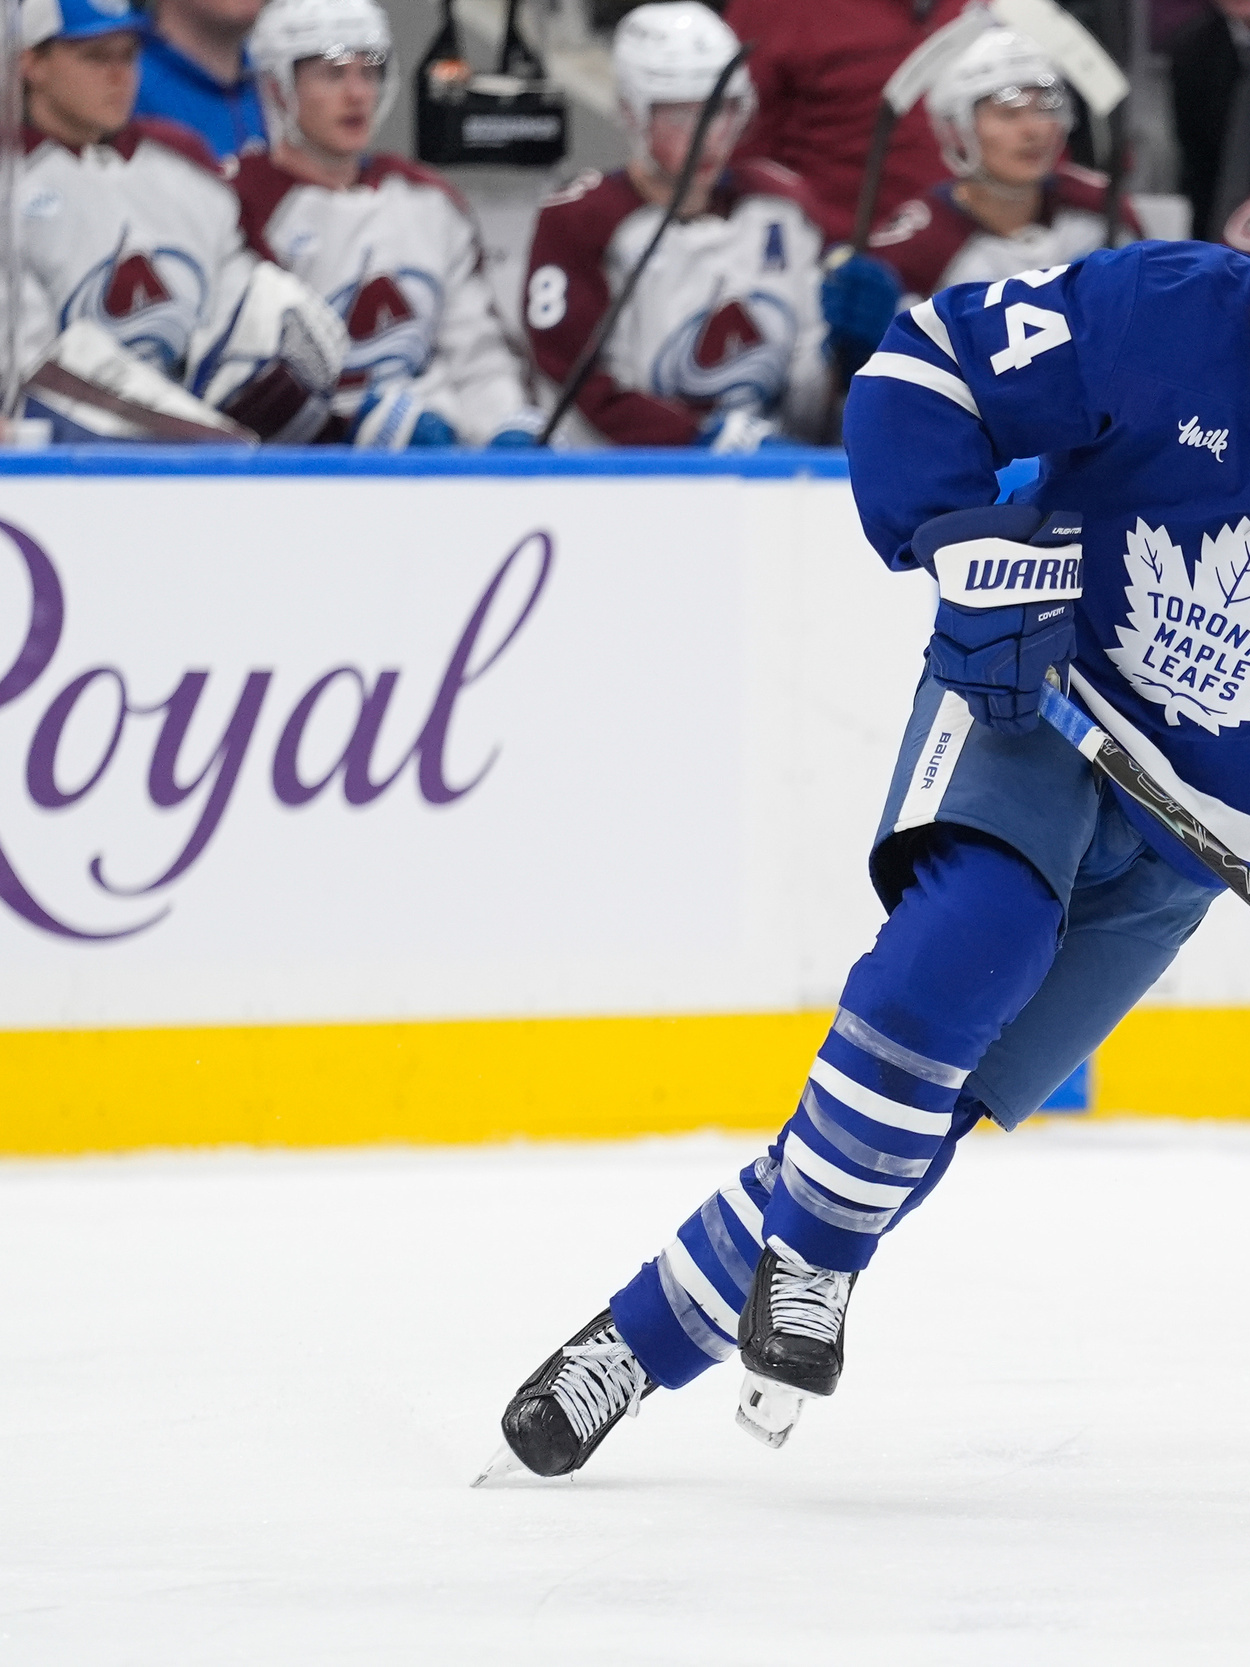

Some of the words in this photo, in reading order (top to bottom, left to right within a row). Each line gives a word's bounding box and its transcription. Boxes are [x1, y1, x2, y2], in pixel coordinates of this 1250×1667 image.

[527, 264, 568, 330] 8
[1178, 415, 1229, 463] Milk
[1038, 606, 1065, 622] COVERT
[1142, 646, 1239, 702] LEAFS
